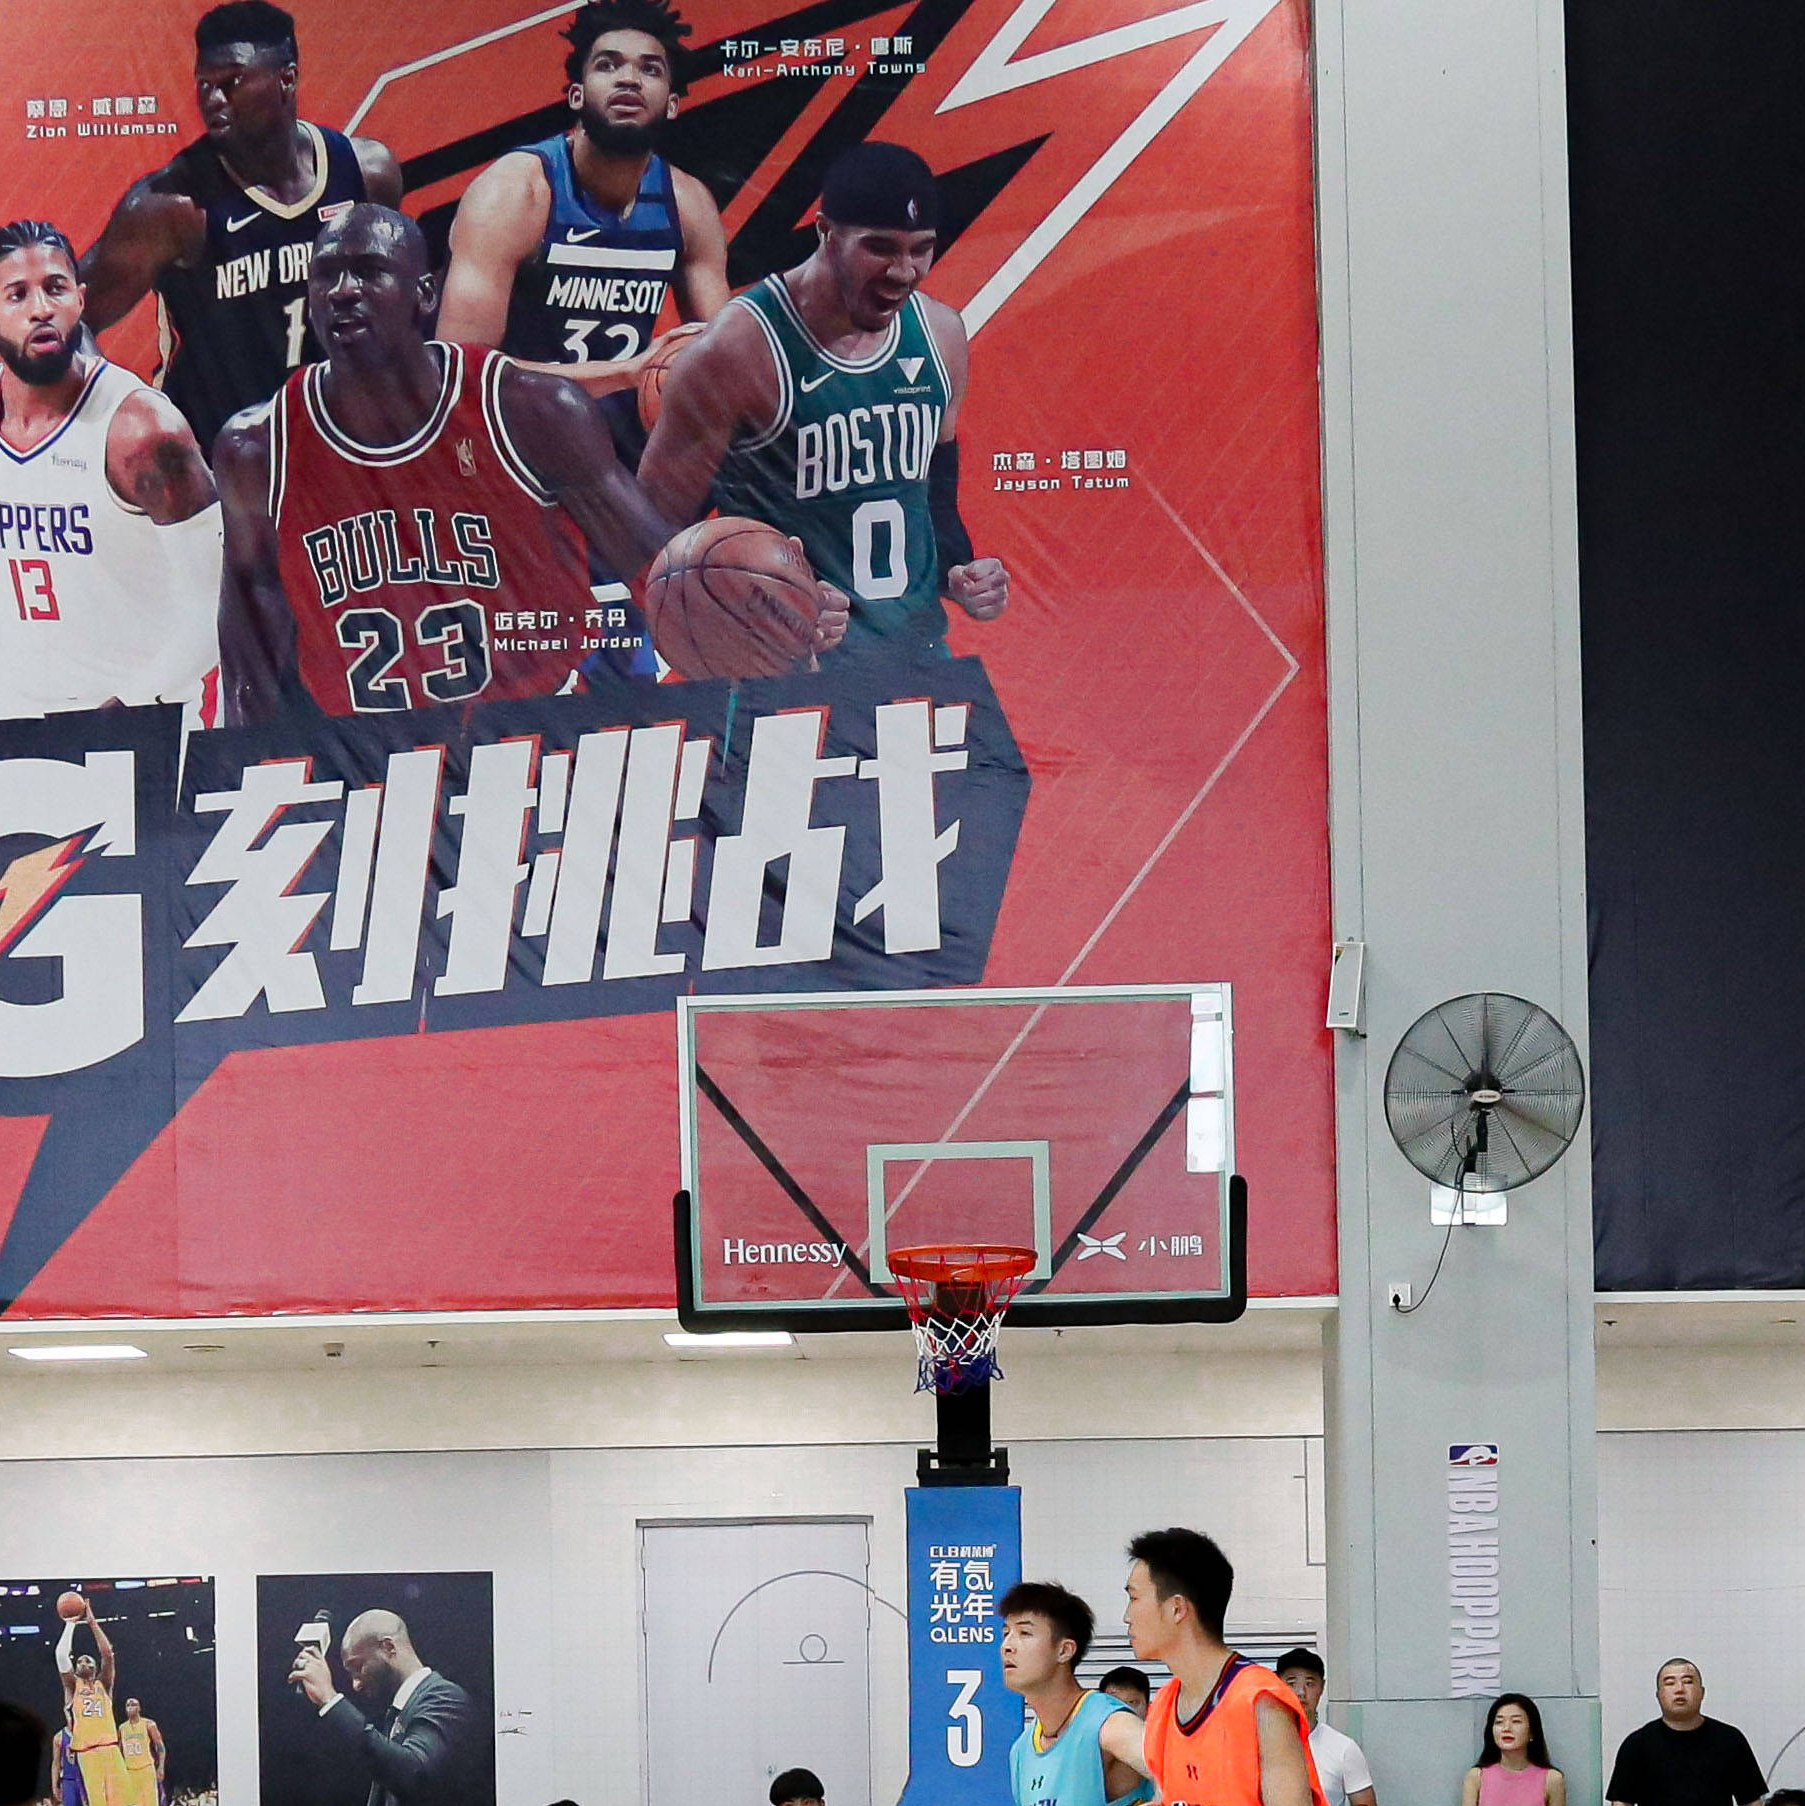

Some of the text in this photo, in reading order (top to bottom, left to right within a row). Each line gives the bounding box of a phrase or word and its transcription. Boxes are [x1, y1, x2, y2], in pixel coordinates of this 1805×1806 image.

[723, 61, 926, 76] Karl-Anthony Towns
[26, 123, 177, 138] Zion Williamson
[216, 249, 271, 299] NEW
[546, 275, 668, 314] MINNESOT
[283, 297, 306, 368] 1
[563, 319, 639, 363] 32
[797, 402, 942, 500] BOSTON
[994, 475, 1129, 491] Jayson Tatum
[303, 508, 500, 608] BULLS
[852, 500, 905, 600] 0
[9, 559, 61, 621] 13
[336, 598, 494, 713] 23
[495, 634, 643, 651] Michael Jordan
[724, 1238, 848, 1267] Hennessy
[81, 1699, 103, 1717] 24
[946, 1669, 984, 1768] 3
